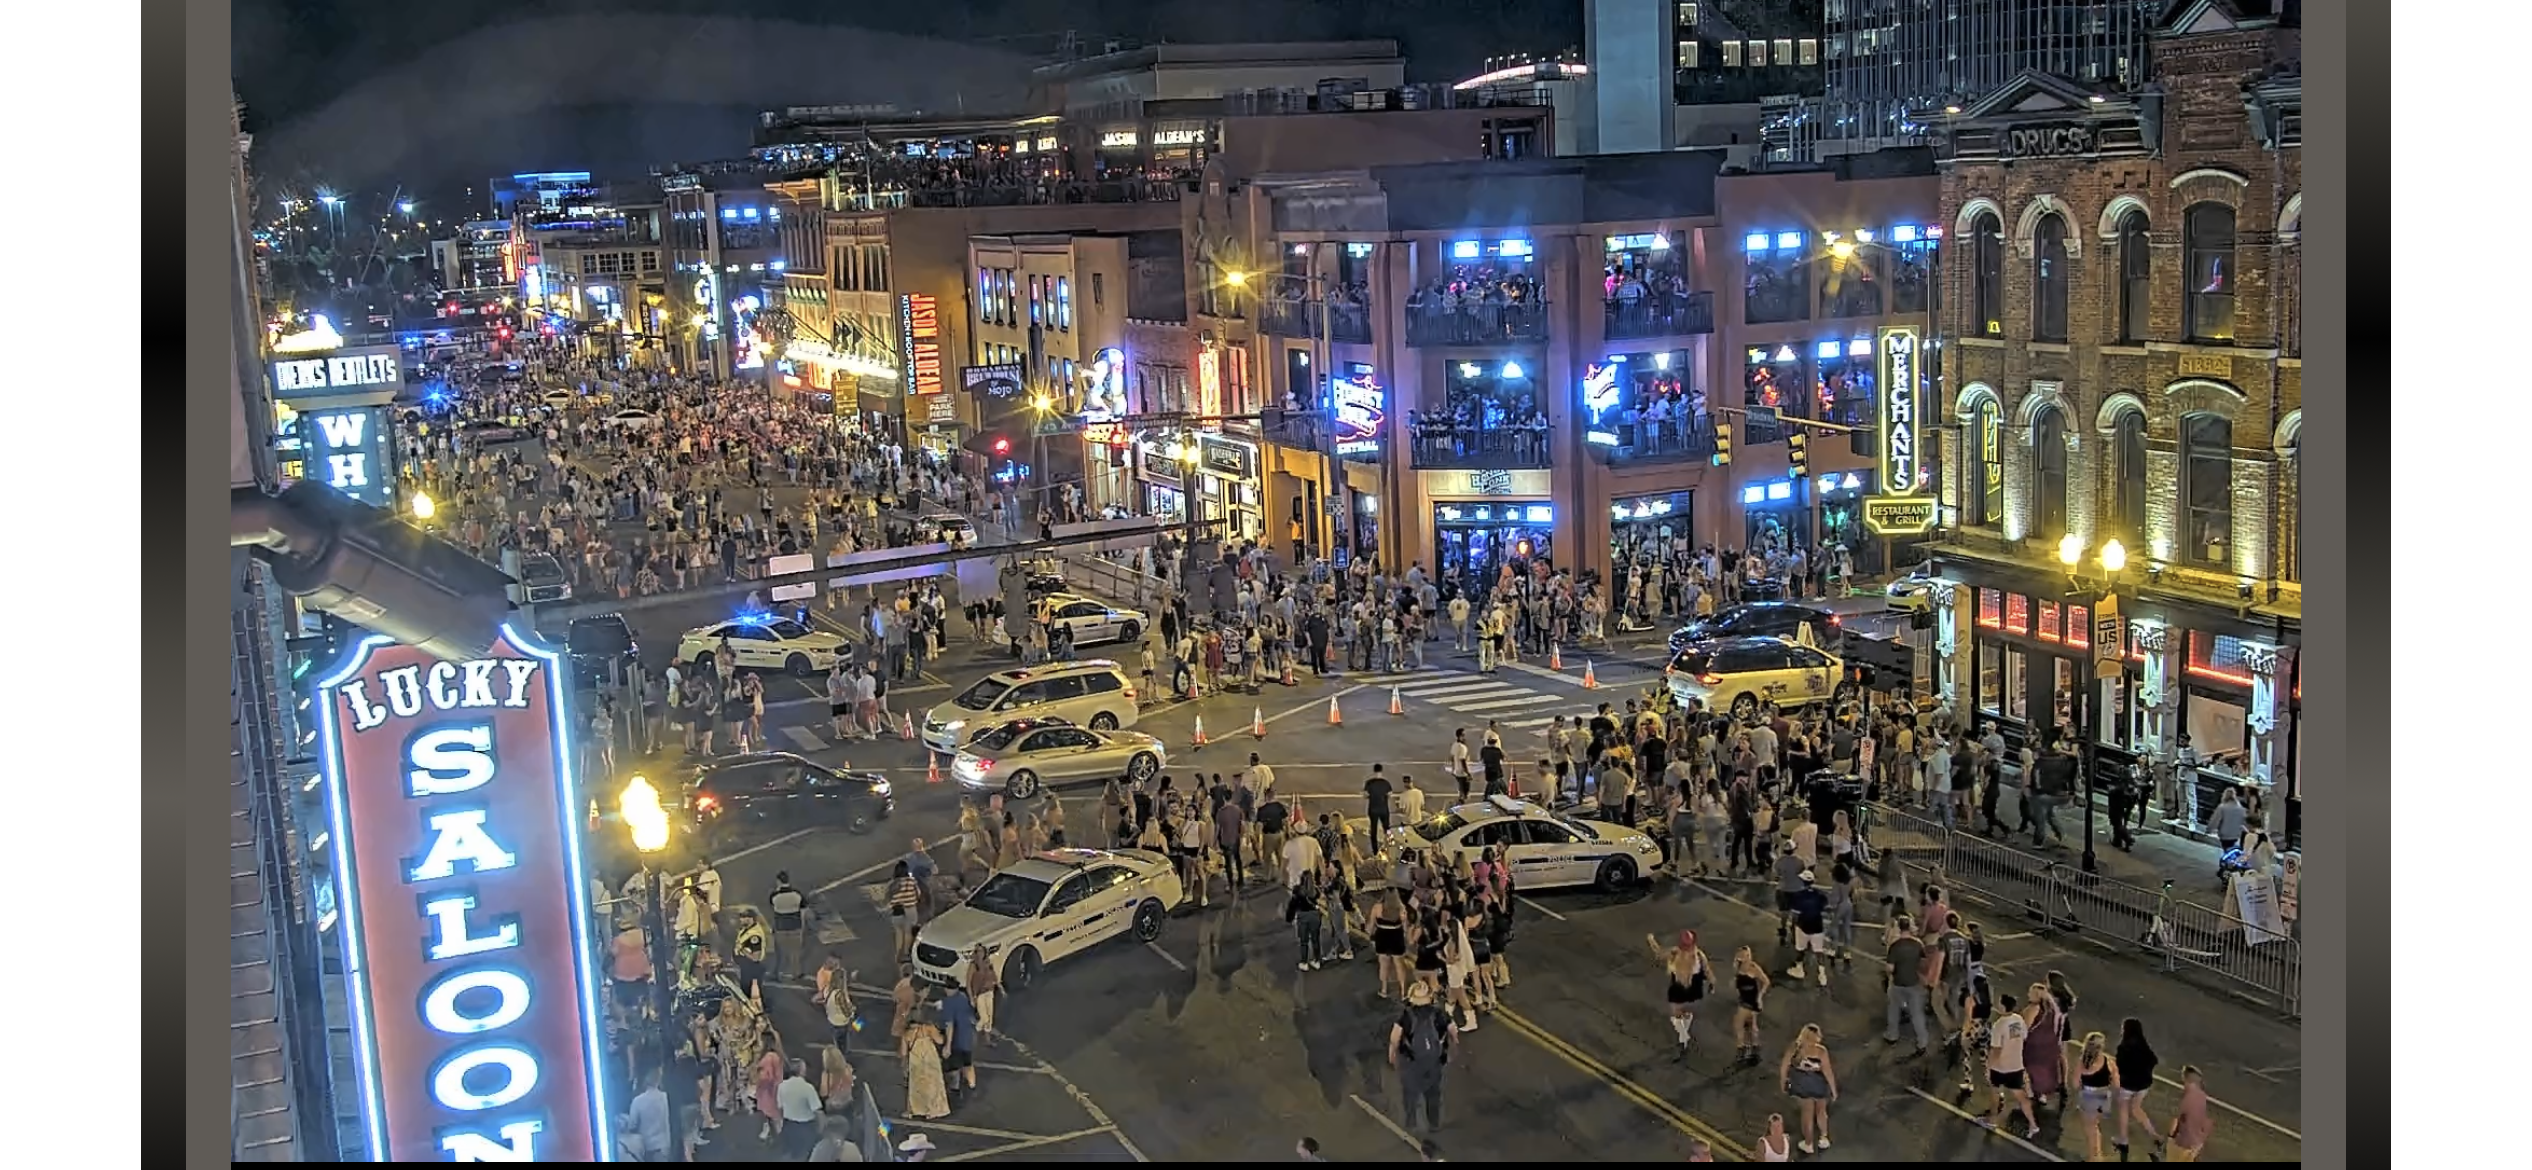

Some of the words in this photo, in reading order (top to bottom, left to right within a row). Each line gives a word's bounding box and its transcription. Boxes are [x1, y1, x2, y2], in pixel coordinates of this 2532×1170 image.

[1102, 132, 1137, 146] JASON
[910, 293, 938, 338] JASON
[914, 343, 942, 395] ALDEAN
[1888, 336, 1912, 490] MERCHANTS
[1872, 505, 1931, 516] RESTAURANT
[1881, 516, 1889, 525] &
[1895, 515, 1922, 525] GRILL
[341, 657, 541, 732] LUCKY
[409, 723, 544, 1163] SALOON
